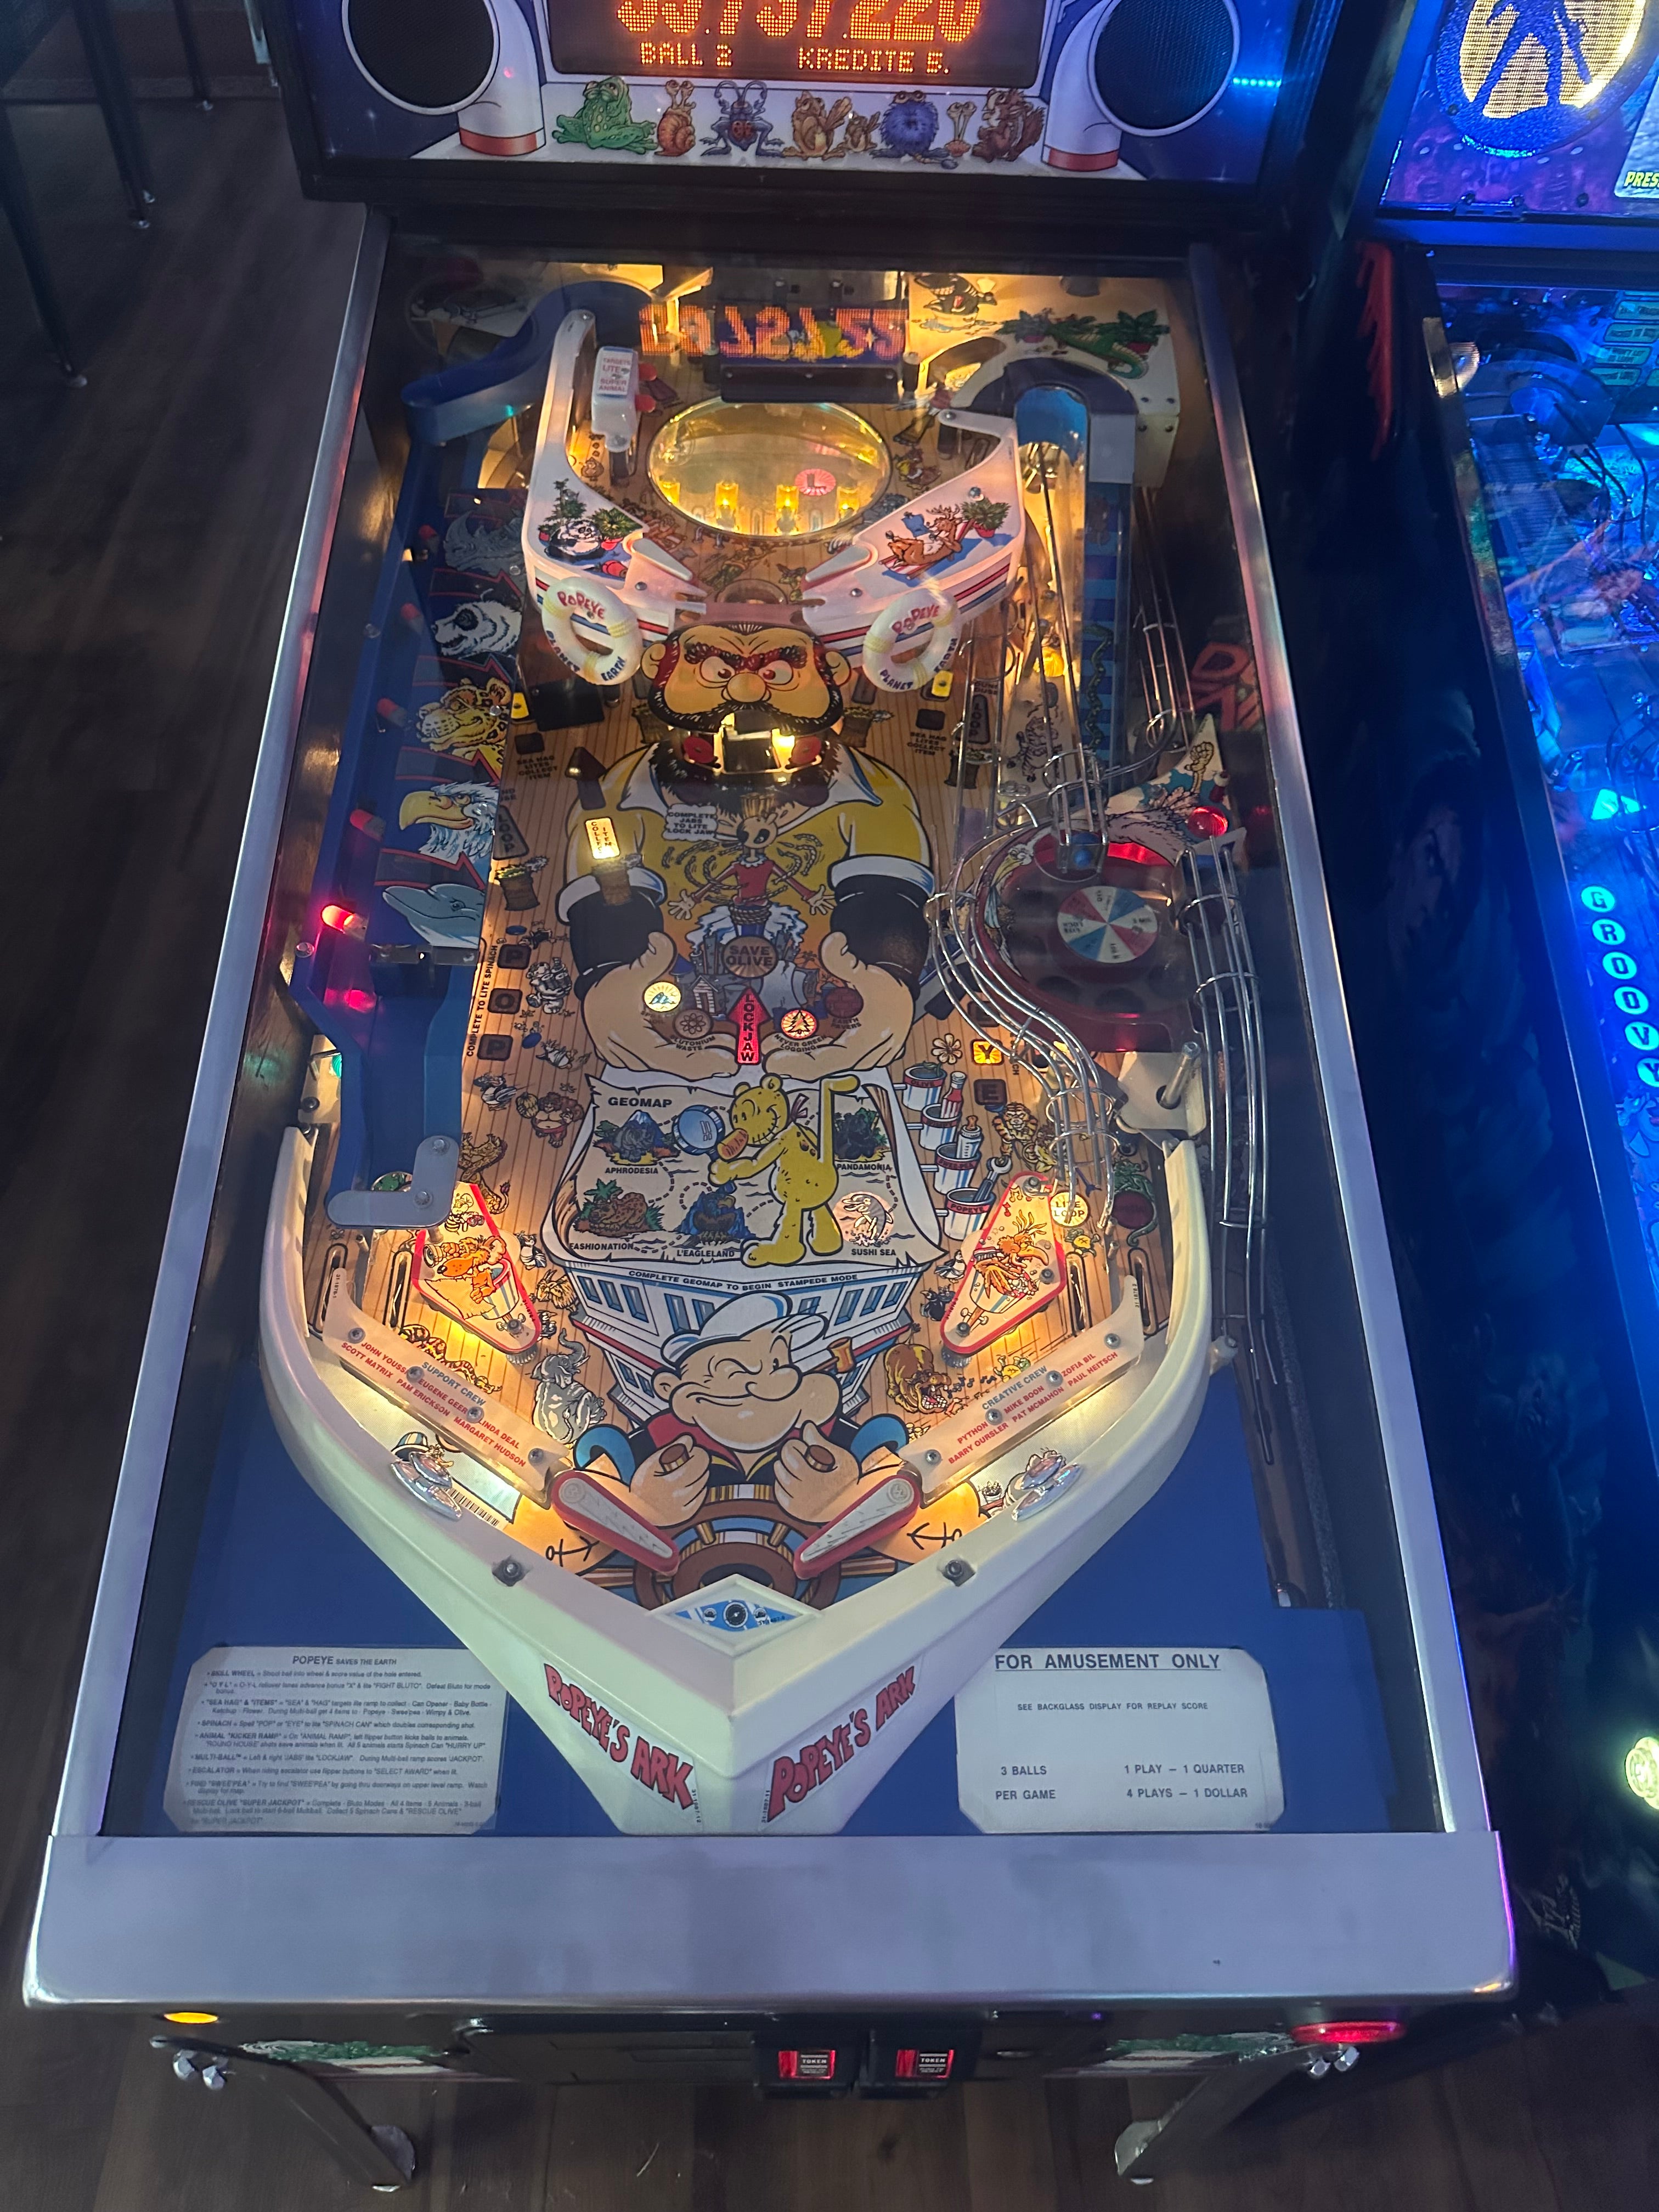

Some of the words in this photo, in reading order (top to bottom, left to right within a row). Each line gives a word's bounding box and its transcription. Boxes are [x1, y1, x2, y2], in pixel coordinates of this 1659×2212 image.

[640, 42, 704, 66] BALL
[716, 44, 733, 66] 2
[798, 47, 915, 72] KREDITE
[1624, 171, 1659, 187] PRES
[557, 591, 605, 619] POPEYE
[891, 605, 940, 634] POPEYE
[601, 656, 627, 681] EARTH
[880, 669, 913, 690] PLANET
[591, 821, 602, 854] COLLEC
[602, 827, 612, 847] ITEM
[729, 945, 770, 956] SAVE
[485, 945, 498, 979] SPINACH
[726, 955, 773, 968] OLIVE
[480, 981, 490, 997] LITE
[477, 1001, 486, 1011] TO
[467, 1014, 483, 1057] COMPLETE
[775, 1034, 799, 1047] NEVER
[802, 1035, 827, 1046] GREEN
[780, 1045, 817, 1053] LOGGING
[911, 1079, 935, 1088] OLIVE
[608, 1097, 673, 1108] GEOMAP
[950, 1203, 984, 1214] POPEYE
[569, 1242, 634, 1250] FASHIONATION
[629, 1270, 679, 1283] COMPLETE
[683, 1277, 723, 1288] GEOMAP
[742, 1283, 771, 1291] BEGIN
[777, 1277, 827, 1288] STAMPEDE
[831, 1274, 857, 1283] MODE
[421, 1361, 461, 1390] SUPPORT
[460, 1387, 487, 1406] CREW
[982, 1380, 1024, 1410] CREATIVE
[1023, 1365, 1047, 1385] CREW
[341, 1342, 366, 1360] SCOTT
[365, 1357, 394, 1378] MATRIX
[396, 1378, 413, 1392] PAM
[413, 1390, 451, 1417] ERICKSON
[453, 1417, 495, 1446] MARGARET
[494, 1443, 526, 1468] HUDSON
[361, 1342, 382, 1357] JOHN
[417, 1378, 447, 1401] EUGENE
[478, 1419, 500, 1436] LINDA
[501, 1432, 520, 1449] DEAL
[957, 1420, 989, 1444] PYTHON
[1004, 1398, 1023, 1415] MIKE
[1022, 1385, 1045, 1402] BOON
[1061, 1360, 1081, 1377] ZOFIA
[948, 1444, 973, 1464] BARRY
[974, 1423, 1009, 1447] OURSLER
[1011, 1410, 1027, 1423] PAT
[1026, 1386, 1065, 1415] MCMAHON
[1067, 1372, 1086, 1387] PAUL
[1087, 1351, 1119, 1375] HEITSCH
[292, 1656, 334, 1664] POPEYE
[995, 1655, 1032, 1669] FOR
[1045, 1654, 1160, 1669] AMUSEMENT
[1171, 1654, 1220, 1669] ONLY
[543, 1663, 630, 1763] POPEYE'S
[630, 1736, 693, 1810] ARK
[768, 1708, 871, 1822] POPEYE'S
[876, 1666, 916, 1732] ARK
[1001, 1766, 1007, 1776] 3
[1012, 1765, 1047, 1776] BALLS
[1135, 1764, 1162, 1774] PLAY
[1193, 1763, 1245, 1774] QUARTER
[996, 1790, 1017, 1800] PER
[1023, 1789, 1056, 1799] GAME
[1127, 1788, 1133, 1798] 4
[1138, 1788, 1173, 1798] PLAYS
[1204, 1787, 1248, 1798] DOLLAR
